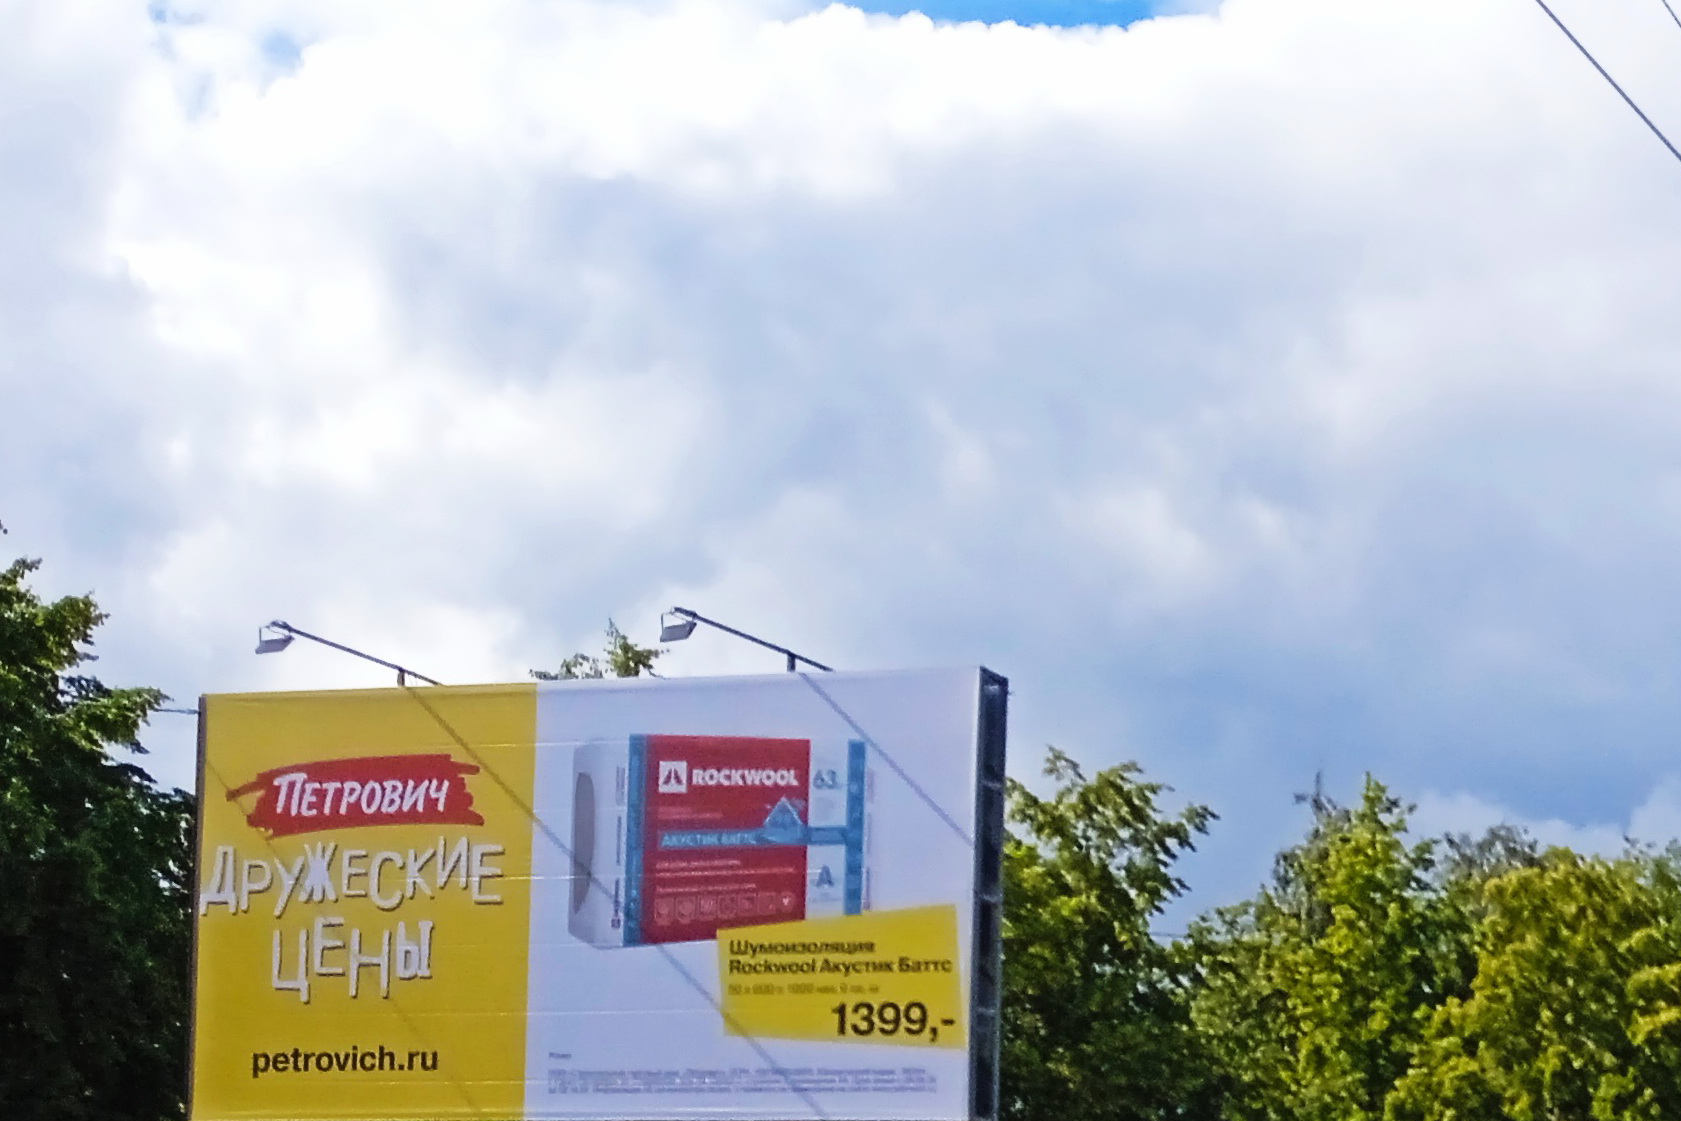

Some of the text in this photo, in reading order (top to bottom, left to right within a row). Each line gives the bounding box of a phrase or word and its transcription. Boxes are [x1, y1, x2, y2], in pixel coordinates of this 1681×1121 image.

[273, 772, 450, 818] ПЕТРОВИЧ
[691, 767, 799, 788] ROCKWOOL
[199, 835, 505, 919] ДРУЖЕСКИЕ
[271, 916, 435, 1004] ЦЕНЫ
[728, 938, 877, 959] Шумоизоляция
[728, 958, 817, 975] Rockwool
[819, 957, 894, 978] Акустик
[251, 1044, 440, 1079] petrovich.ru
